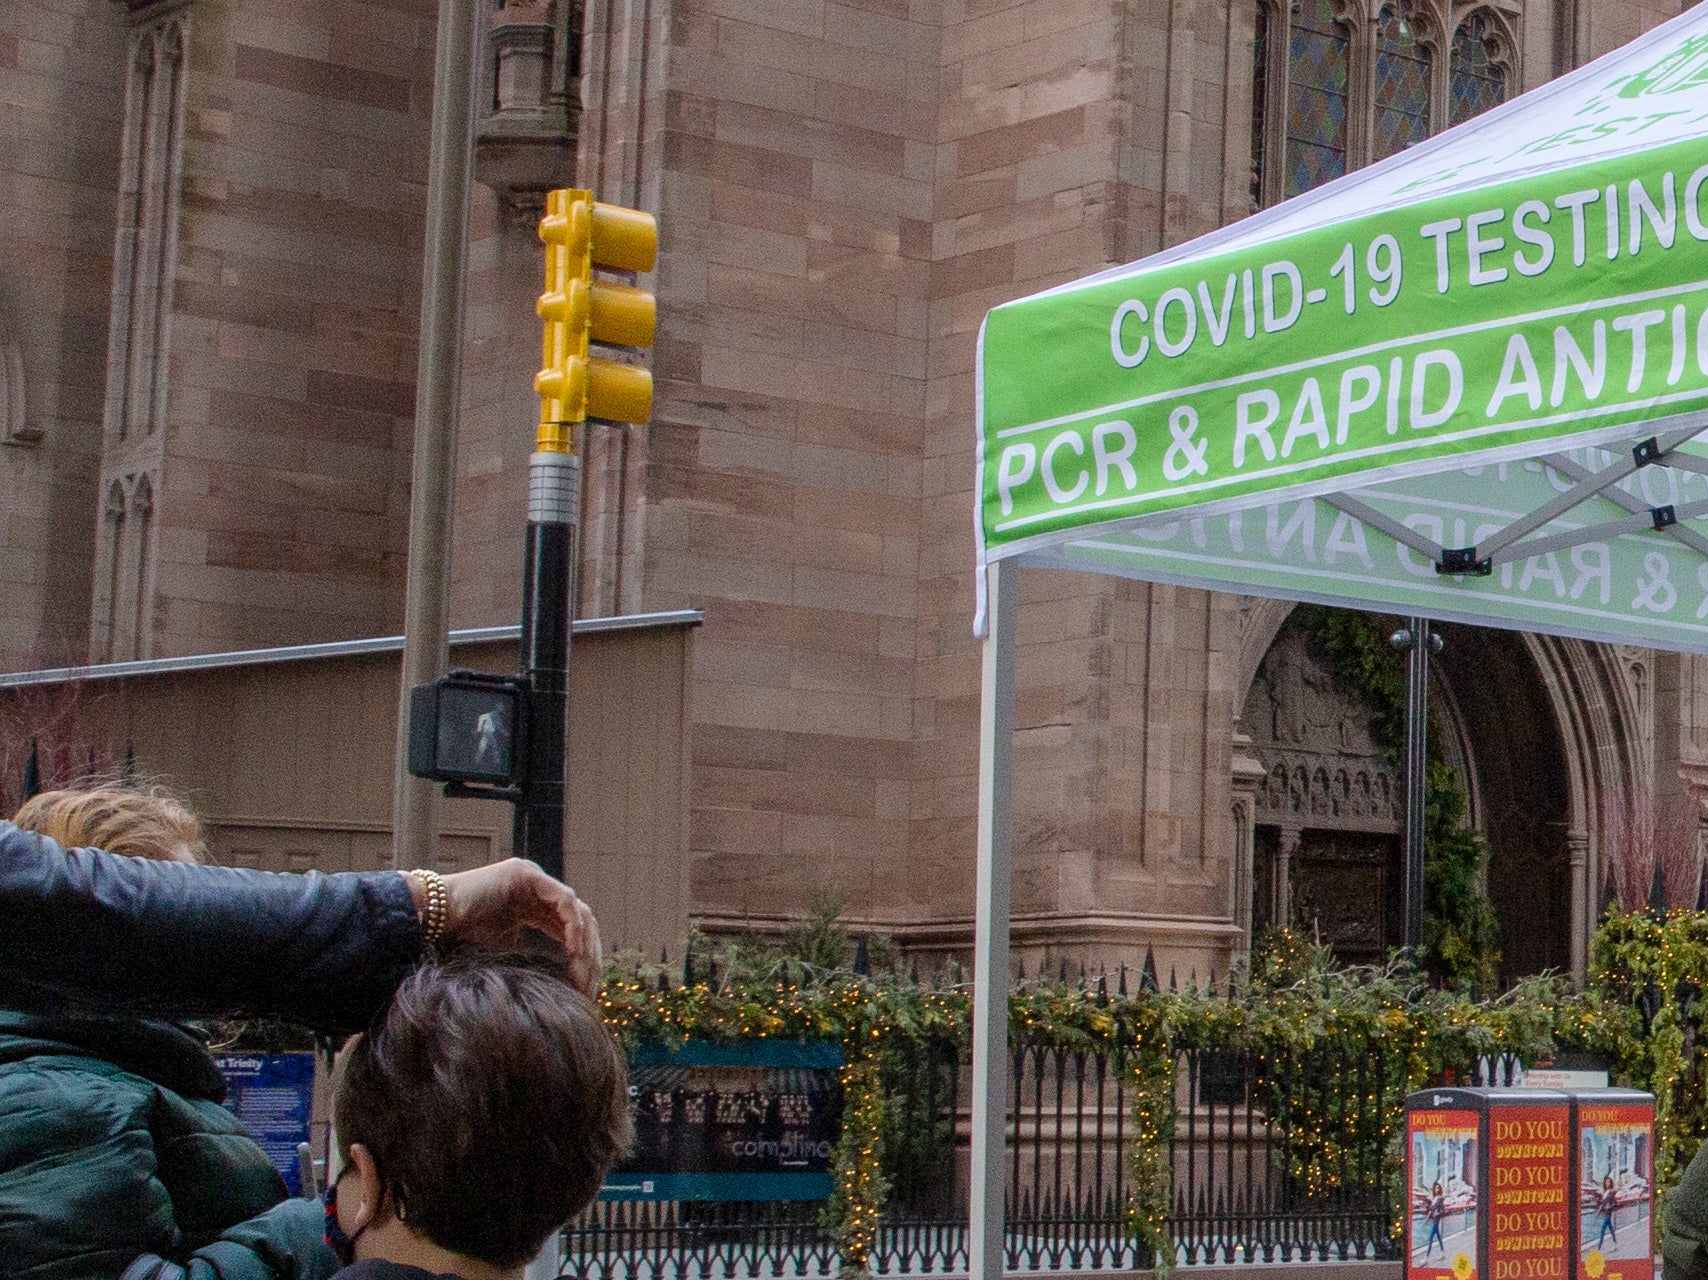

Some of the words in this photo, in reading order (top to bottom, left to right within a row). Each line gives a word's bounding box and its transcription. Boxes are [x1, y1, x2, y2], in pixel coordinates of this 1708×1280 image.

[1110, 232, 1403, 369] COVID-19
[998, 417, 1139, 517] PCR
[1162, 404, 1209, 479] &
[1231, 349, 1465, 467] RAPID
[1496, 1121, 1522, 1140] DO
[1496, 1167, 1522, 1186] DO
[1496, 1213, 1522, 1233] DO
[1496, 1260, 1522, 1279] DO
